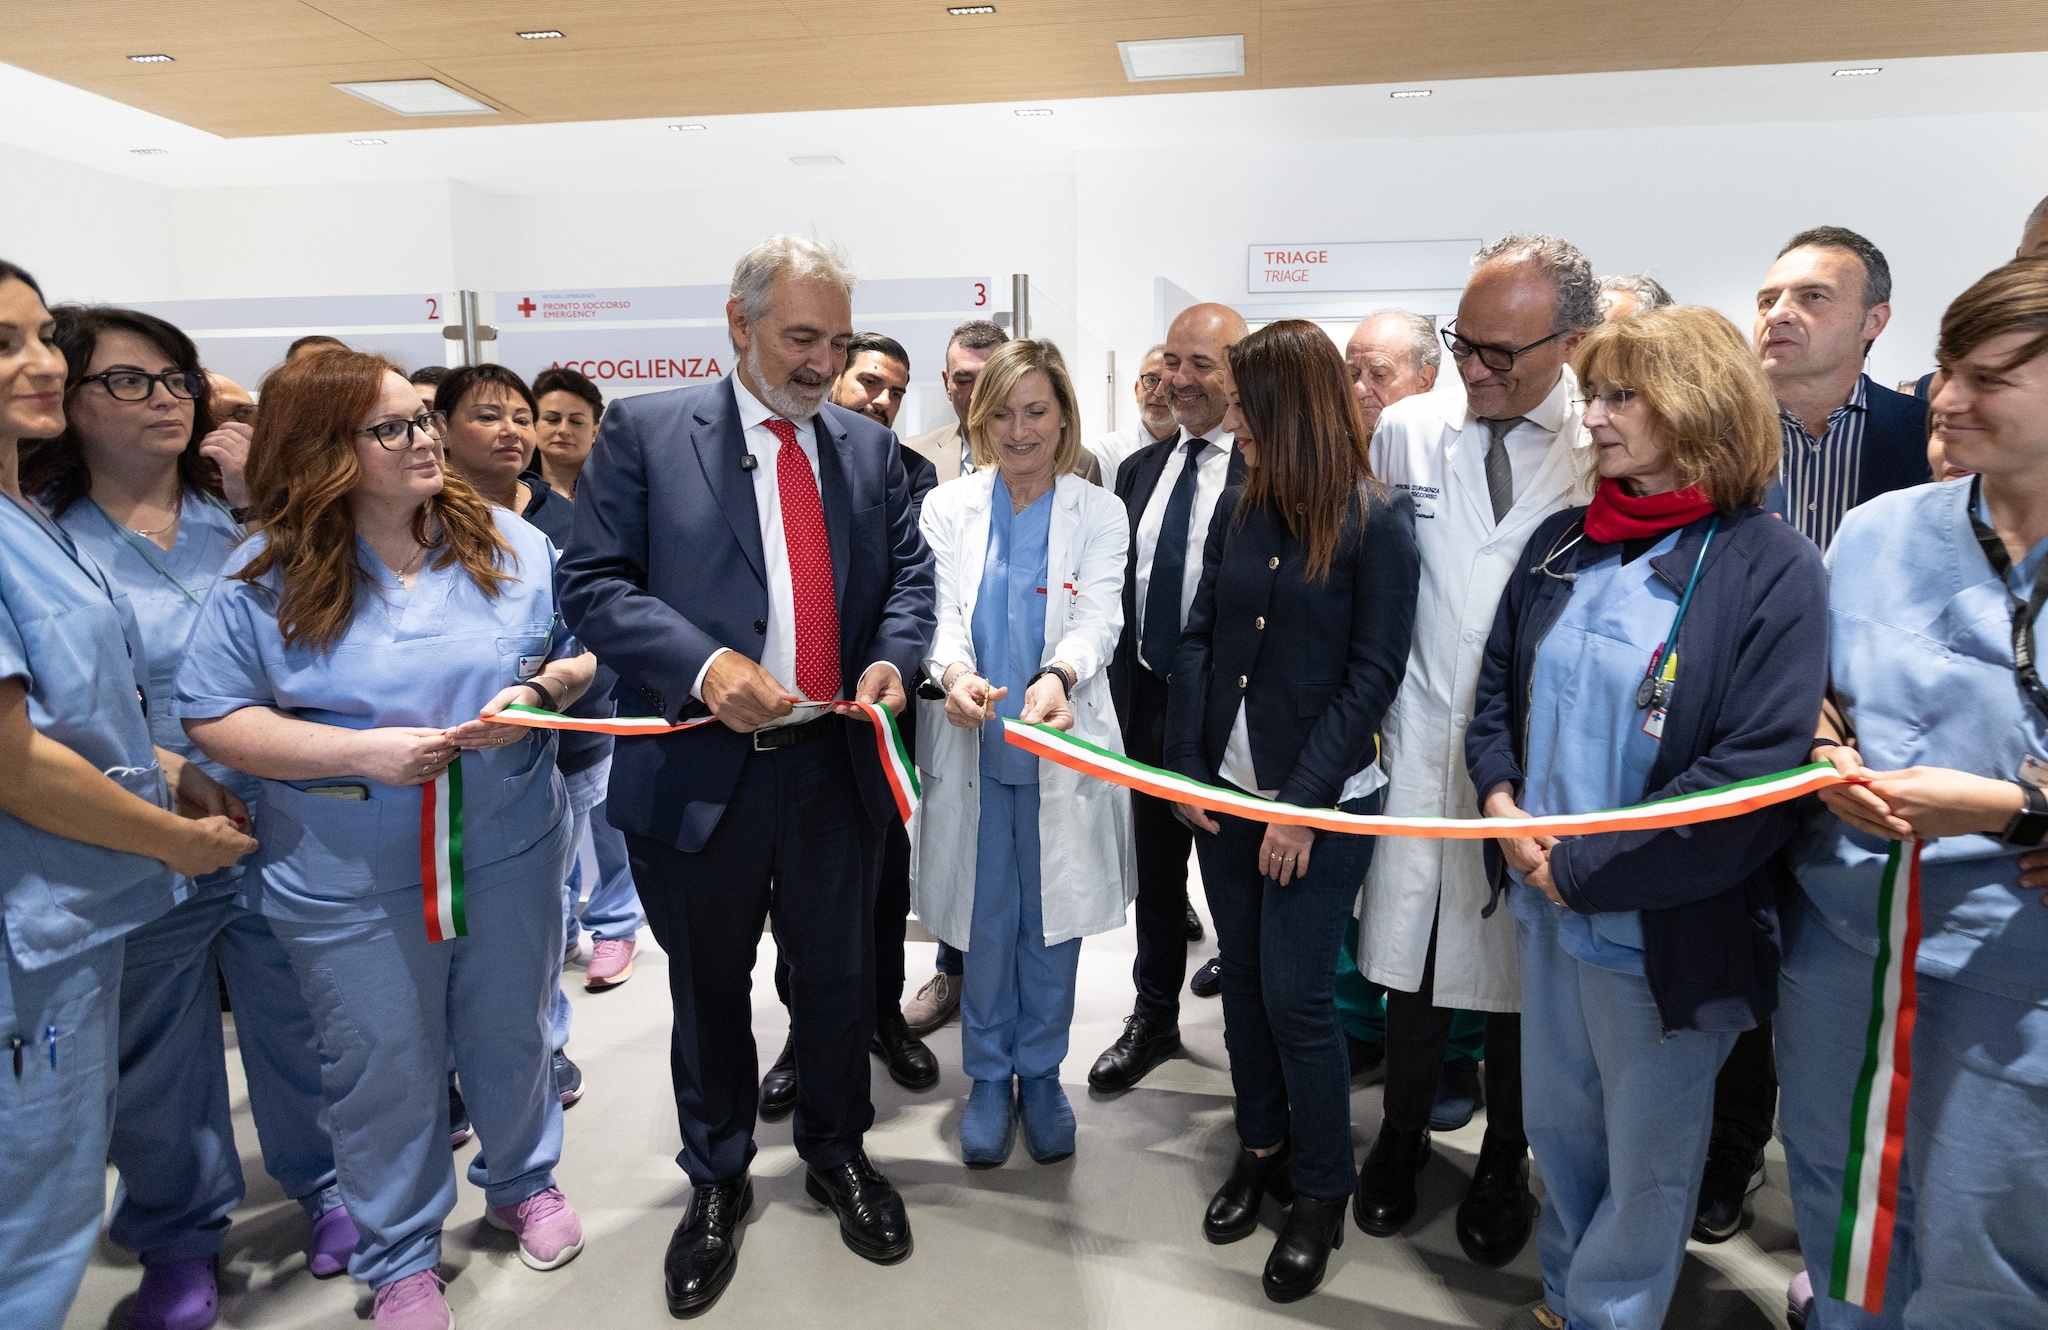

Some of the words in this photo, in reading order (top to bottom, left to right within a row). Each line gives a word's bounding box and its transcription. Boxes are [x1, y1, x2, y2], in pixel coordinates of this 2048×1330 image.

[1264, 250, 1328, 264] TRIAGE
[1264, 269, 1310, 283] TRIAGE
[974, 283, 987, 306] 3
[426, 298, 440, 320] 2
[543, 302, 581, 310] PRONTO
[582, 301, 631, 309] SOCCORSO
[543, 310, 597, 318] EMERGENCY
